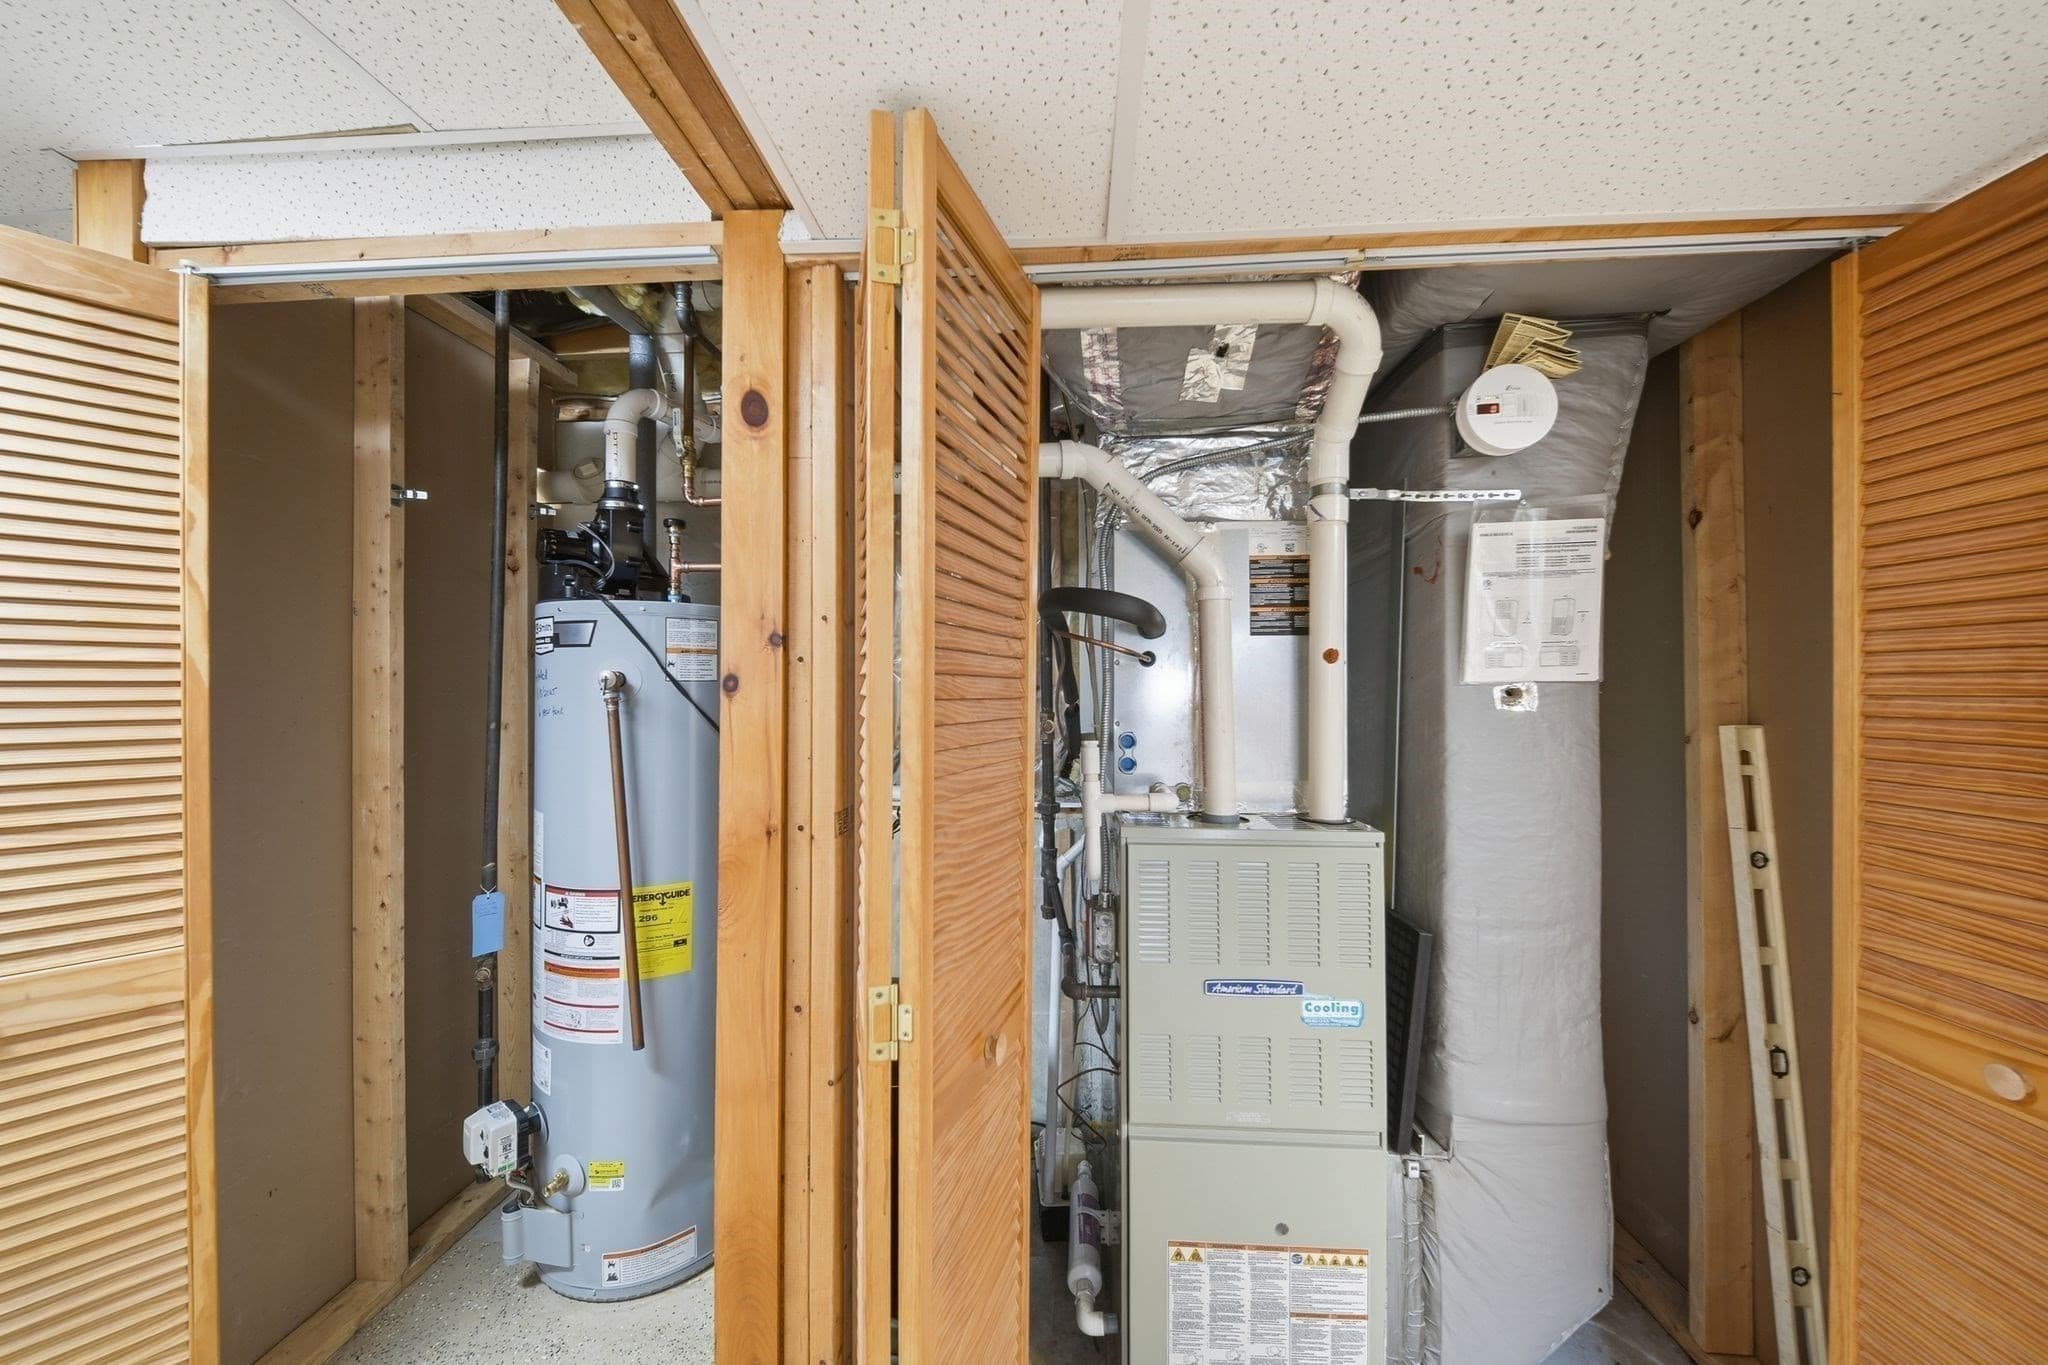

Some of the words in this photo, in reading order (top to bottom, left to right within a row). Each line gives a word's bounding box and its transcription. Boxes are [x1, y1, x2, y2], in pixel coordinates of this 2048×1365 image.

[1212, 983, 1253, 994] American
[1254, 984, 1297, 995] Standard
[1305, 1002, 1359, 1016] Cooling
